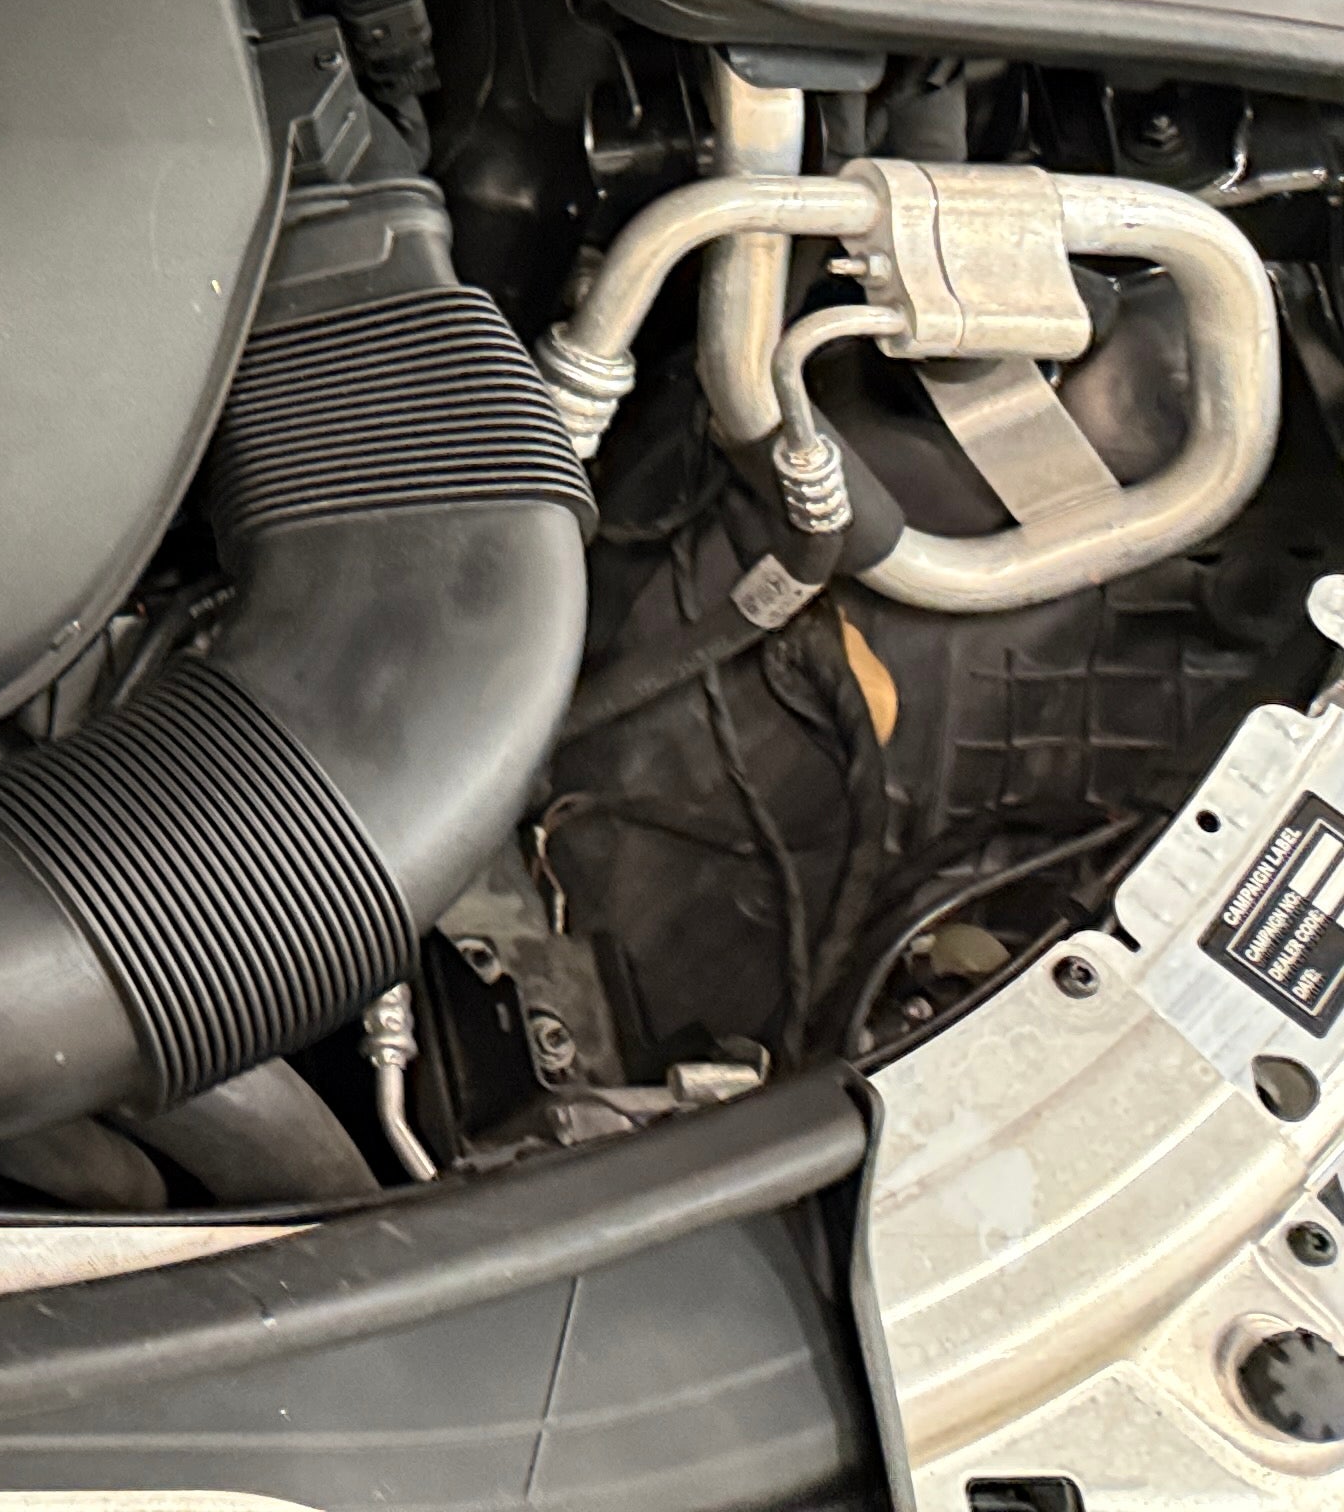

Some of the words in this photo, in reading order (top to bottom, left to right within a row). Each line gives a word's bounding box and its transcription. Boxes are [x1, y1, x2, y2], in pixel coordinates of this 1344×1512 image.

[1223, 854, 1275, 927] CAMPAIGN
[1269, 827, 1303, 866] LABEL
[1245, 908, 1284, 962] CAMPAIGN
[1268, 938, 1302, 982] DEALER
[1294, 909, 1325, 944] CODE:
[1291, 968, 1324, 1000] DATE:
